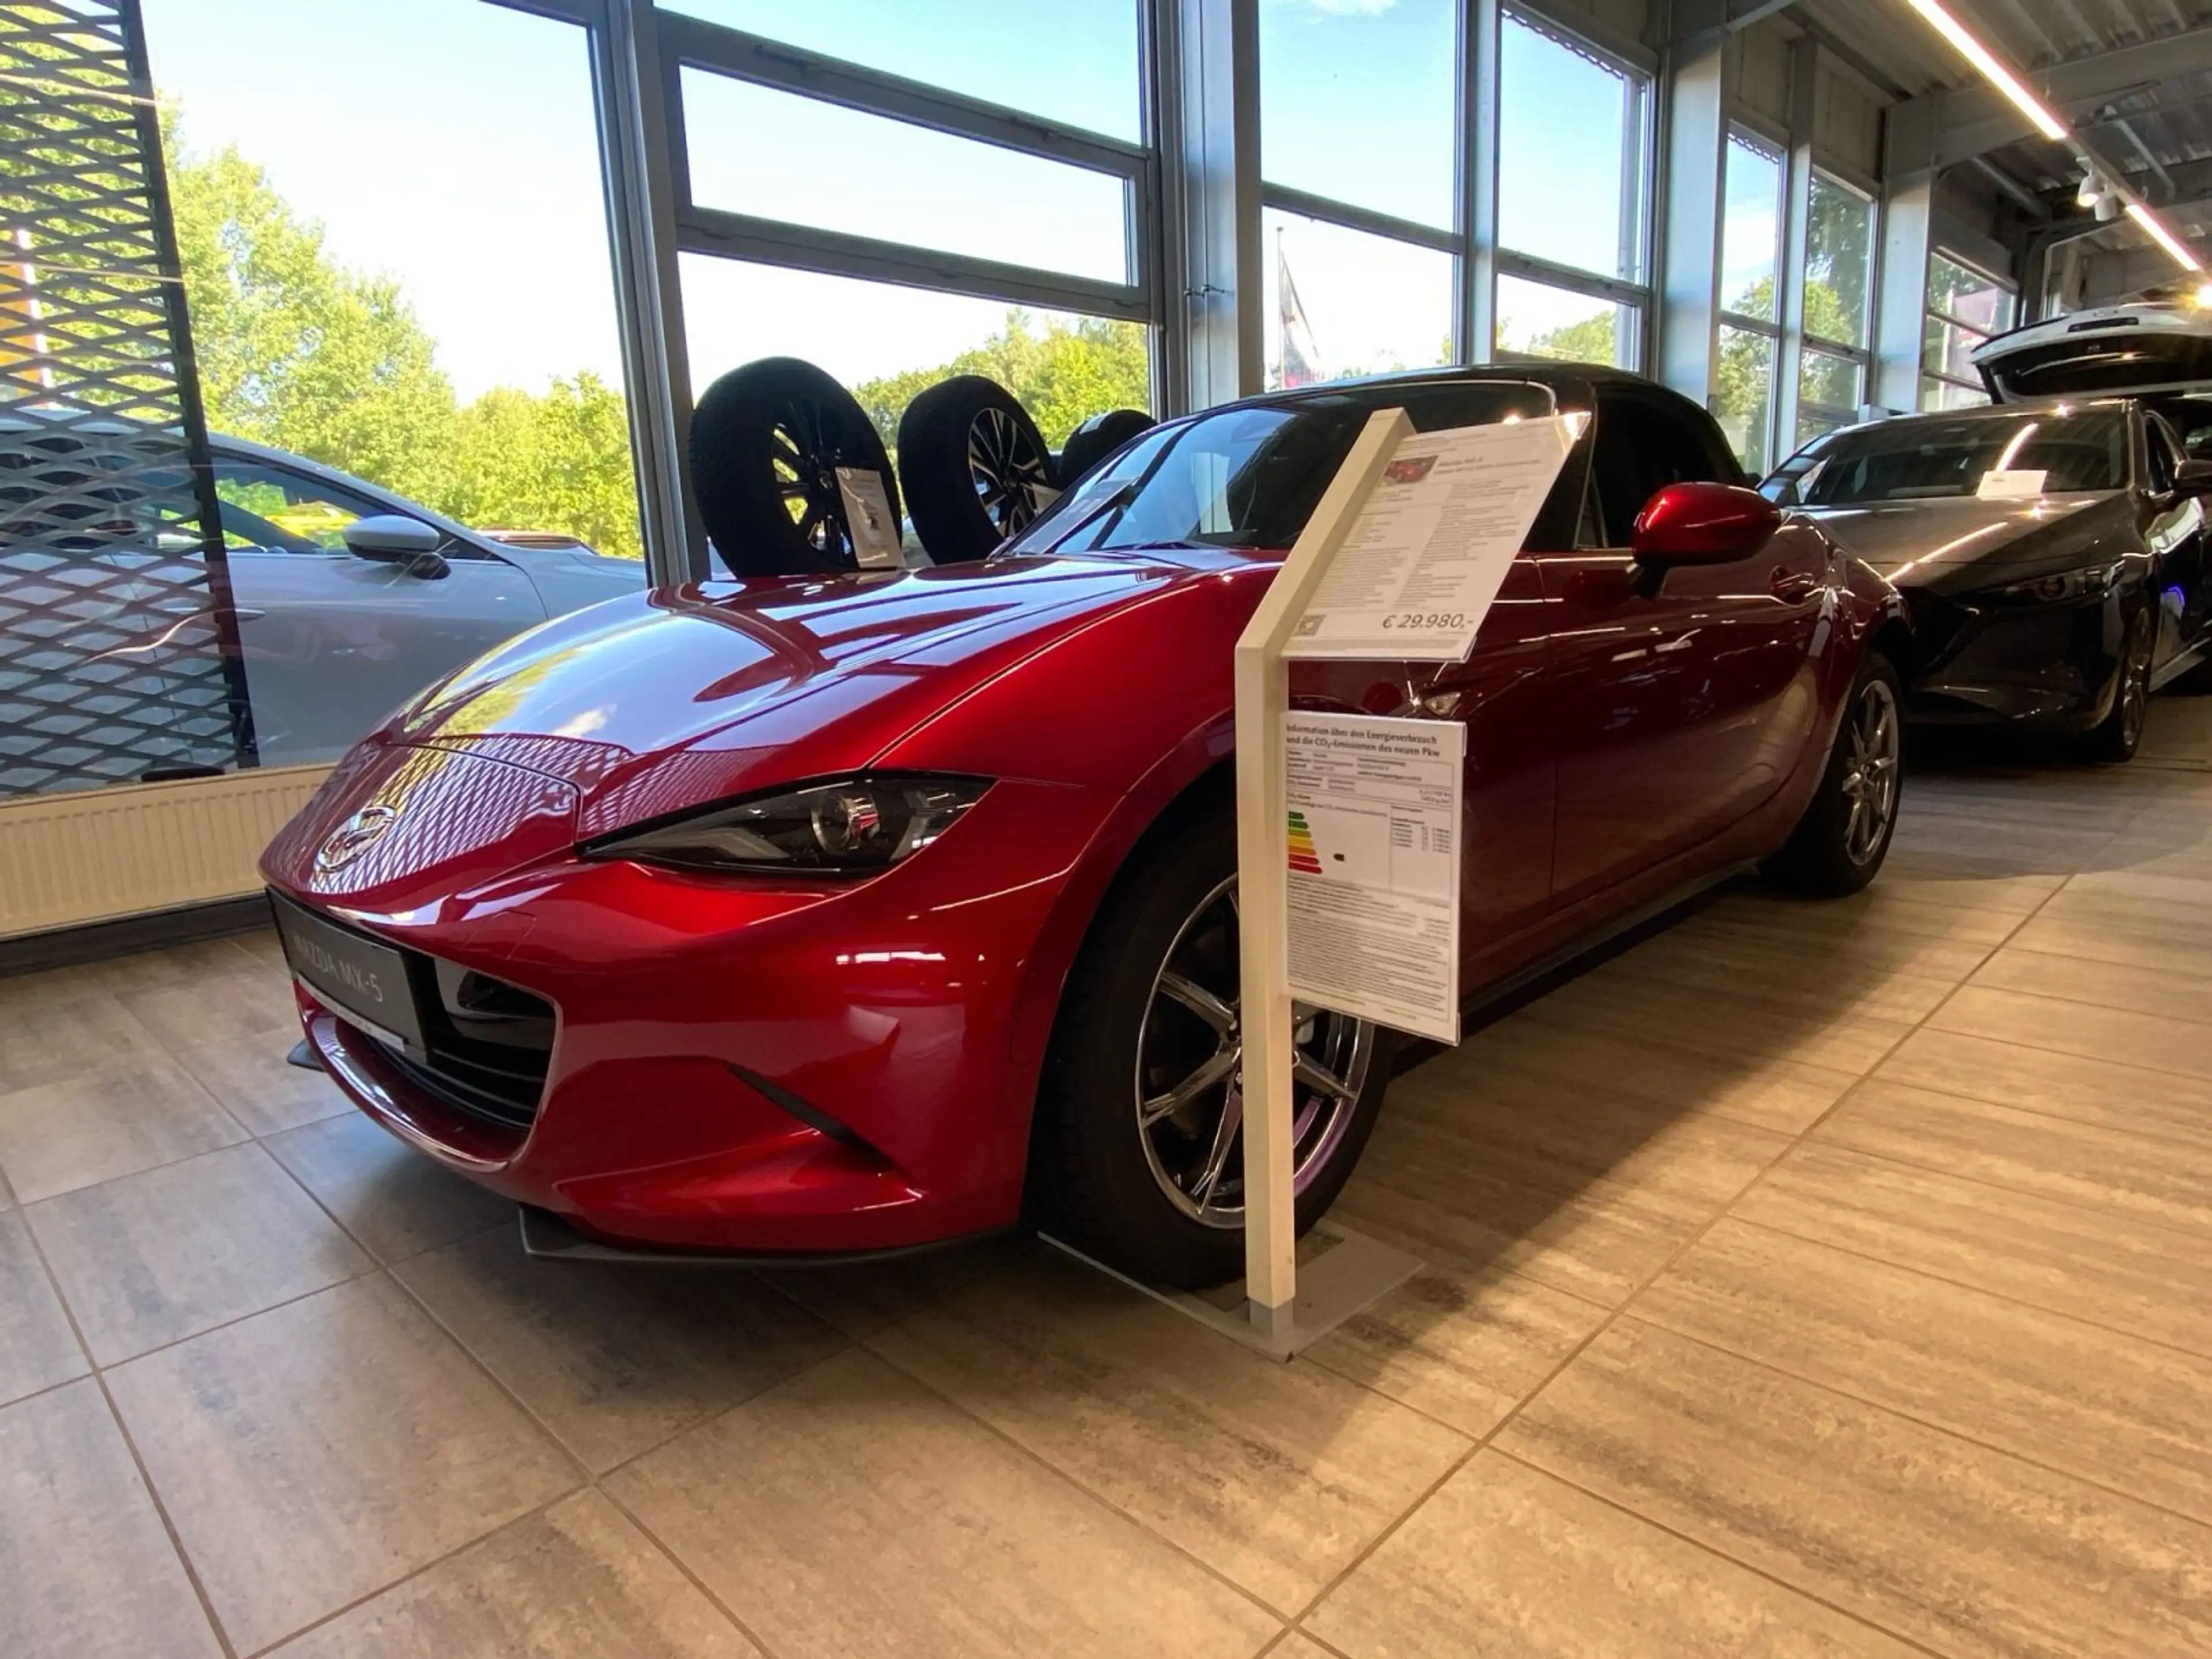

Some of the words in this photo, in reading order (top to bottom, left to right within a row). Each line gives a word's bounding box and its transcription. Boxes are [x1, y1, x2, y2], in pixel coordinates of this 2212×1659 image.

[1382, 614, 1396, 628] €
[1286, 724, 1328, 734] Information
[1331, 726, 1348, 736] über
[1349, 729, 1365, 738] den
[1366, 730, 1437, 745] Energieverbrauch
[1286, 736, 1300, 744] und
[1302, 735, 1313, 745] die
[1378, 743, 1392, 753] des
[1393, 747, 1419, 755] neuen
[1421, 747, 1440, 757] Pkw
[293, 931, 340, 980] MAZDA
[339, 959, 383, 1003] MX-5
